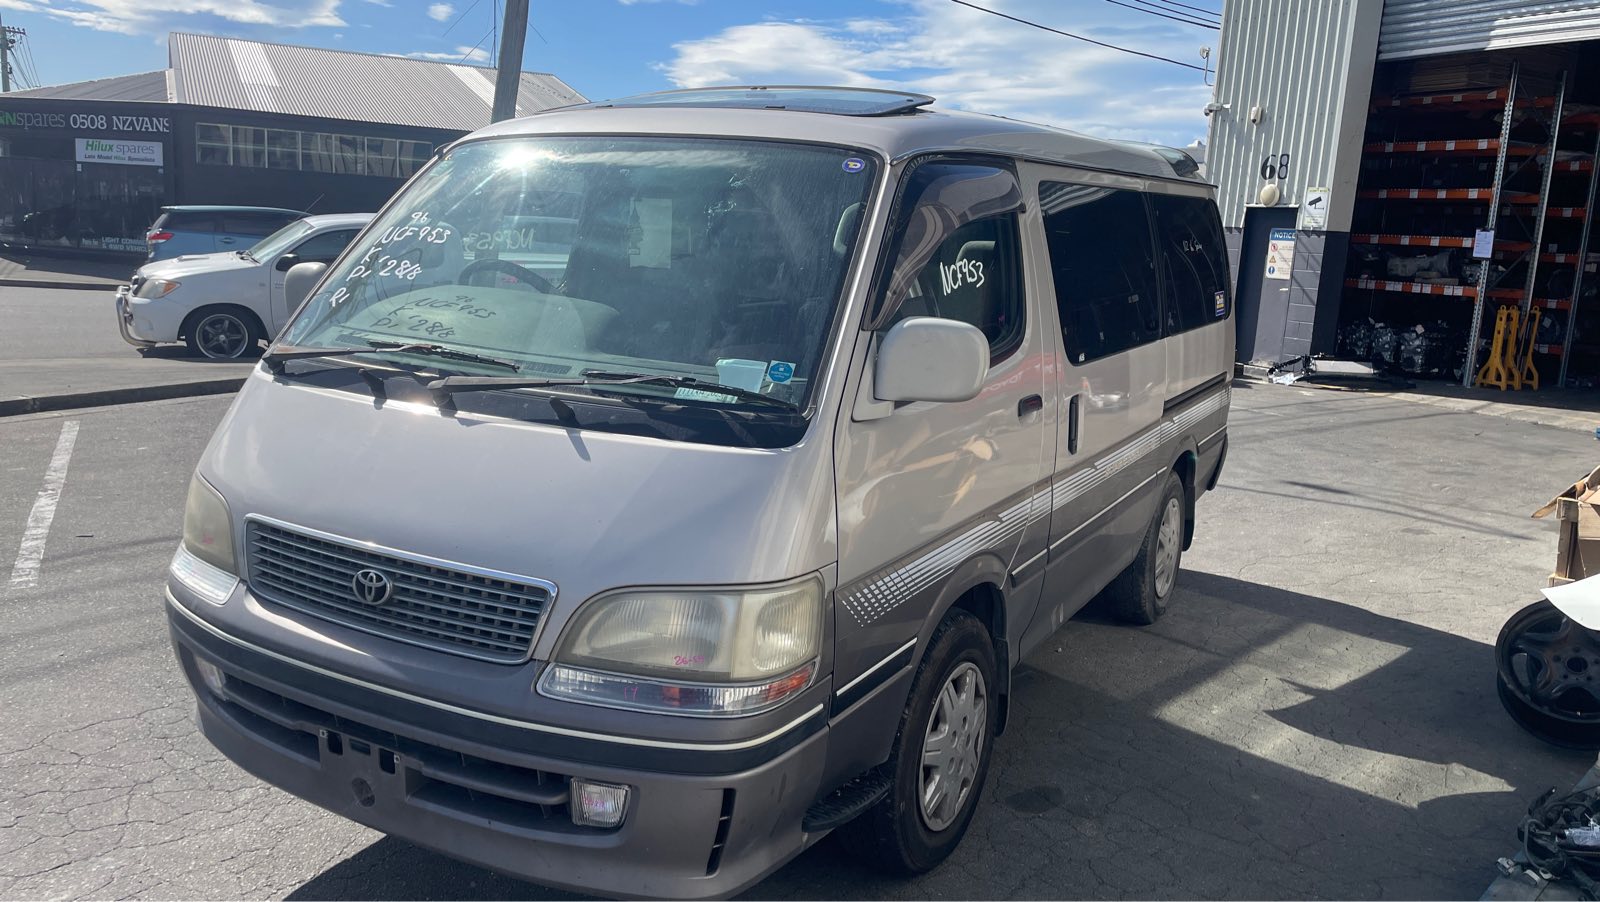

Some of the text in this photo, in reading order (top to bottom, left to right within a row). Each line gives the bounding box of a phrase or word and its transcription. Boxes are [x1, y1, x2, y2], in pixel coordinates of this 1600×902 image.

[70, 113, 107, 130] 0508
[112, 115, 170, 133] NZVANS
[85, 140, 155, 155] Hilux spares
[1261, 154, 1290, 181] 68
[411, 211, 429, 224] 96
[1274, 231, 1296, 239] NOTICE
[939, 258, 985, 296] NCF953
